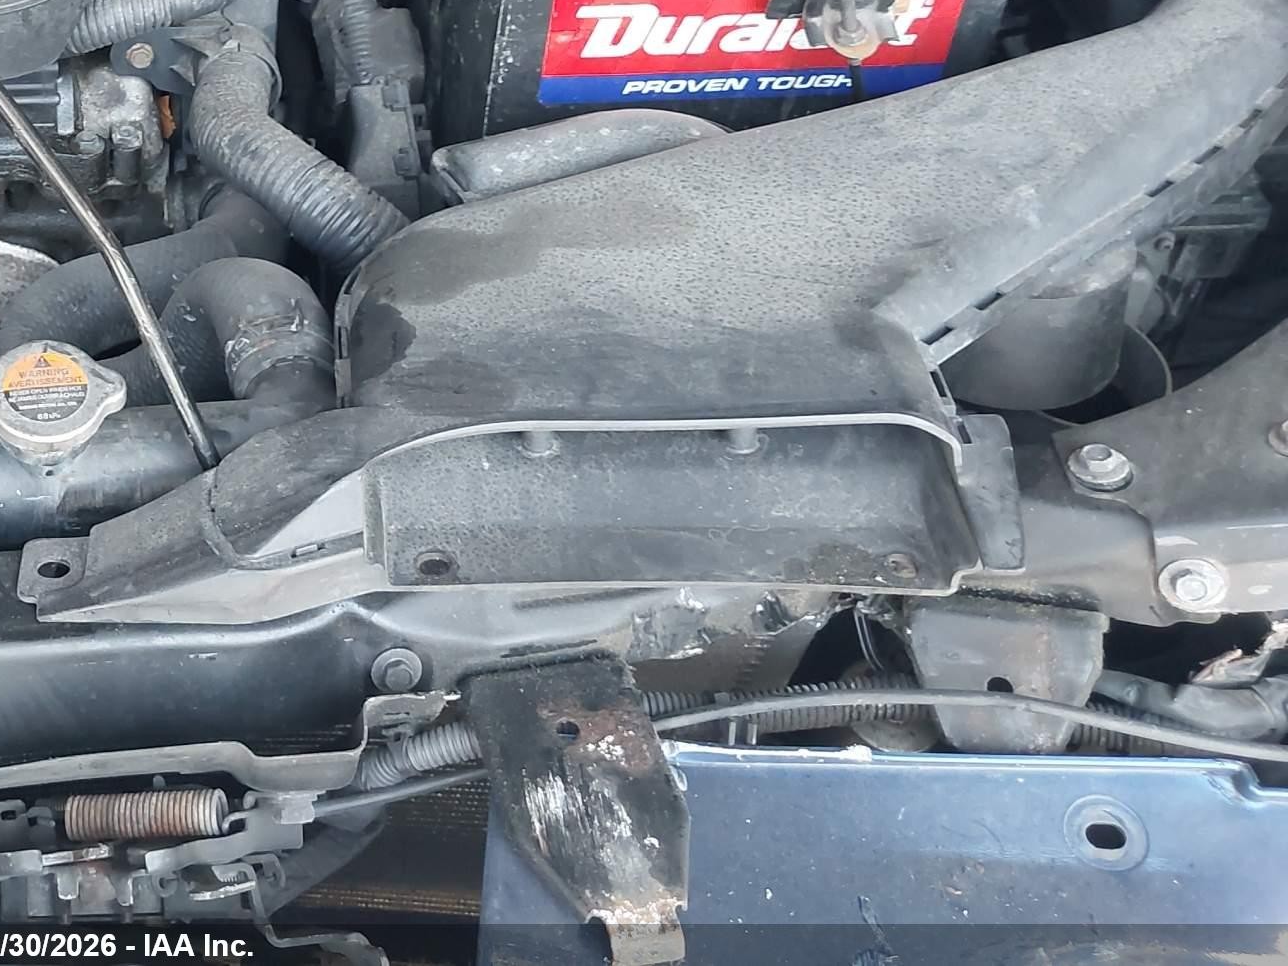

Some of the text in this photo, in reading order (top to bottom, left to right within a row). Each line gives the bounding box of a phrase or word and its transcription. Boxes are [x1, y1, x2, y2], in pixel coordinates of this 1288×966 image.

[622, 76, 754, 96] PROVEN
[19, 369, 69, 379] WARNING
[9, 377, 82, 388] AVERTISSEMENT
